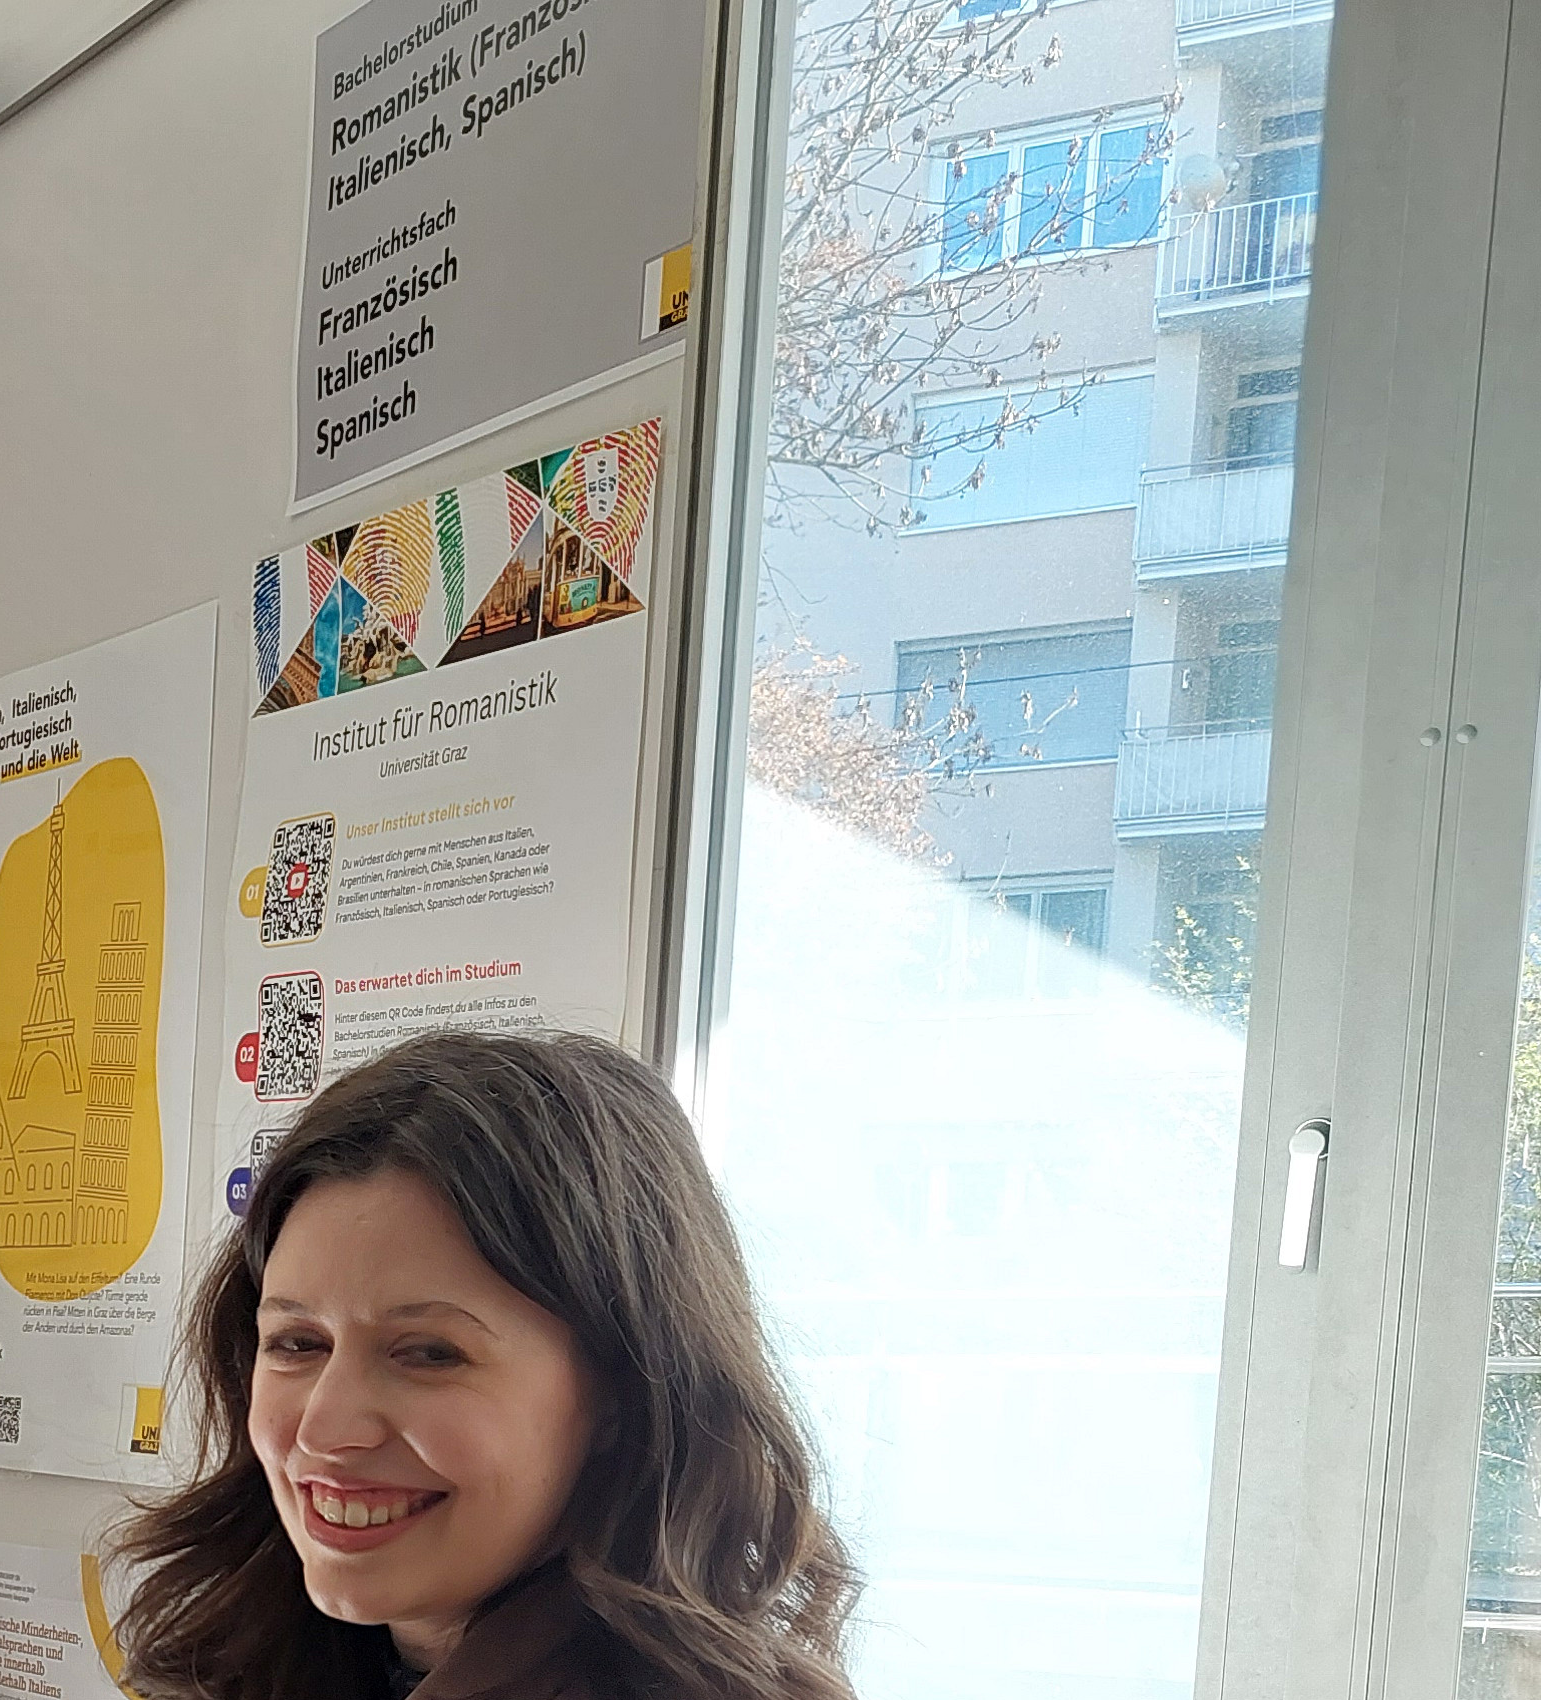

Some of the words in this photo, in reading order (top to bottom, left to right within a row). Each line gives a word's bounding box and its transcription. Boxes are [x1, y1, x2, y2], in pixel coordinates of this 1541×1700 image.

[333, 0, 479, 100] Bachelorstudium
[331, 53, 462, 155] Romanistik
[470, 0, 586, 78] (Franz
[327, 115, 452, 210] Italienisch,
[462, 30, 587, 137] Spanisch)
[321, 199, 456, 290] Unterrichtsfach
[318, 248, 457, 345] Französisch
[316, 317, 434, 400] Italienisch
[316, 381, 416, 459] Spanisch
[12, 680, 76, 718] Italienisch,
[314, 717, 387, 761] Institut
[392, 706, 424, 741] für
[429, 670, 559, 733] Romanistik
[1, 752, 23, 778] und
[28, 749, 46, 770] die
[51, 738, 79, 764] Welt
[380, 751, 439, 778] Universität
[442, 746, 468, 763] Graz
[346, 821, 380, 839] Unser
[382, 810, 425, 832] Institut
[428, 801, 460, 824] stellt
[464, 797, 490, 816] sich
[493, 794, 515, 809] vor
[444, 837, 486, 852] Menschen
[488, 834, 503, 844] aus
[246, 884, 260, 900] 01
[335, 979, 356, 994] Das
[359, 972, 412, 992] erwartet
[416, 967, 442, 986] dich
[446, 966, 461, 982] im
[465, 960, 521, 981] Studium
[389, 1008, 400, 1021] QR
[239, 1048, 254, 1063] 02
[232, 1184, 247, 1199] 03
[46, 1646, 63, 1661] und
